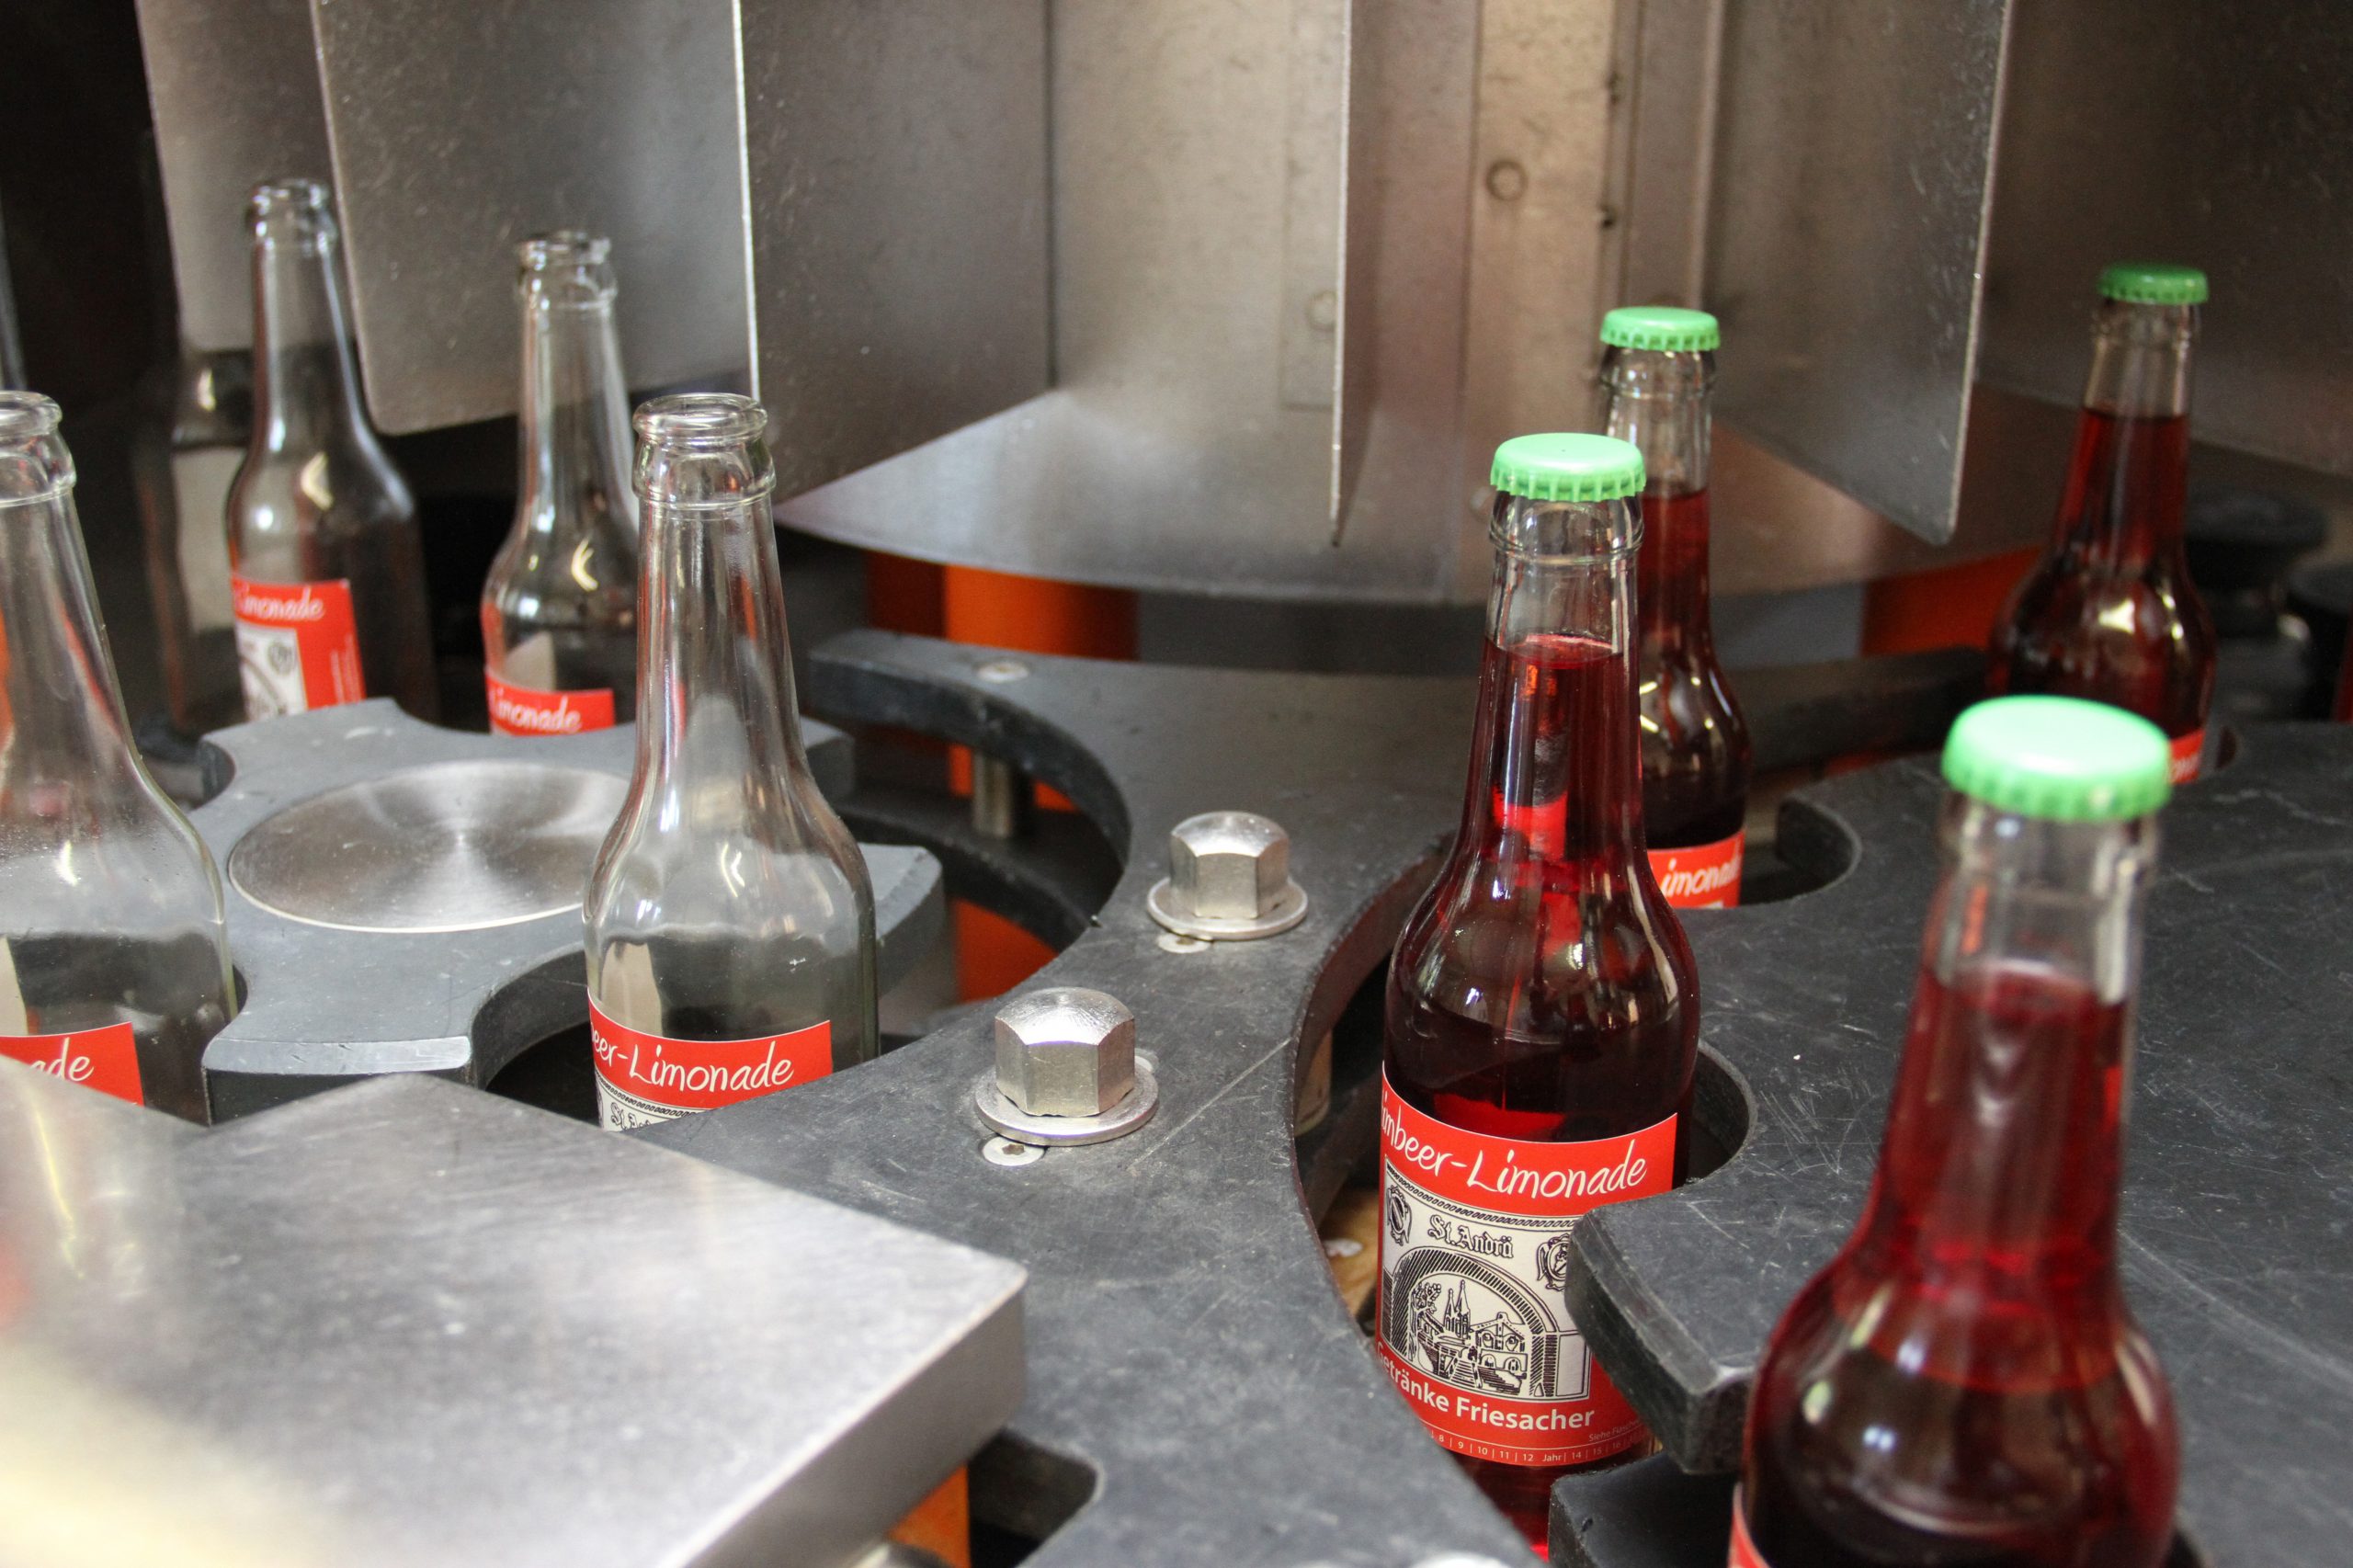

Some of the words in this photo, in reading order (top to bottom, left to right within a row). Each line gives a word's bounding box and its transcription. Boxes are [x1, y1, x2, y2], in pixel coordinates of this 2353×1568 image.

[1456, 1396, 1595, 1431] Friesacher
[1438, 1434, 1445, 1443] 8
[1458, 1440, 1464, 1449] 9
[1477, 1446, 1488, 1455] 10
[1499, 1450, 1510, 1460] 11
[1522, 1453, 1534, 1462] 12
[1542, 1453, 1562, 1463] Jahr
[1571, 1451, 1582, 1460] 14
